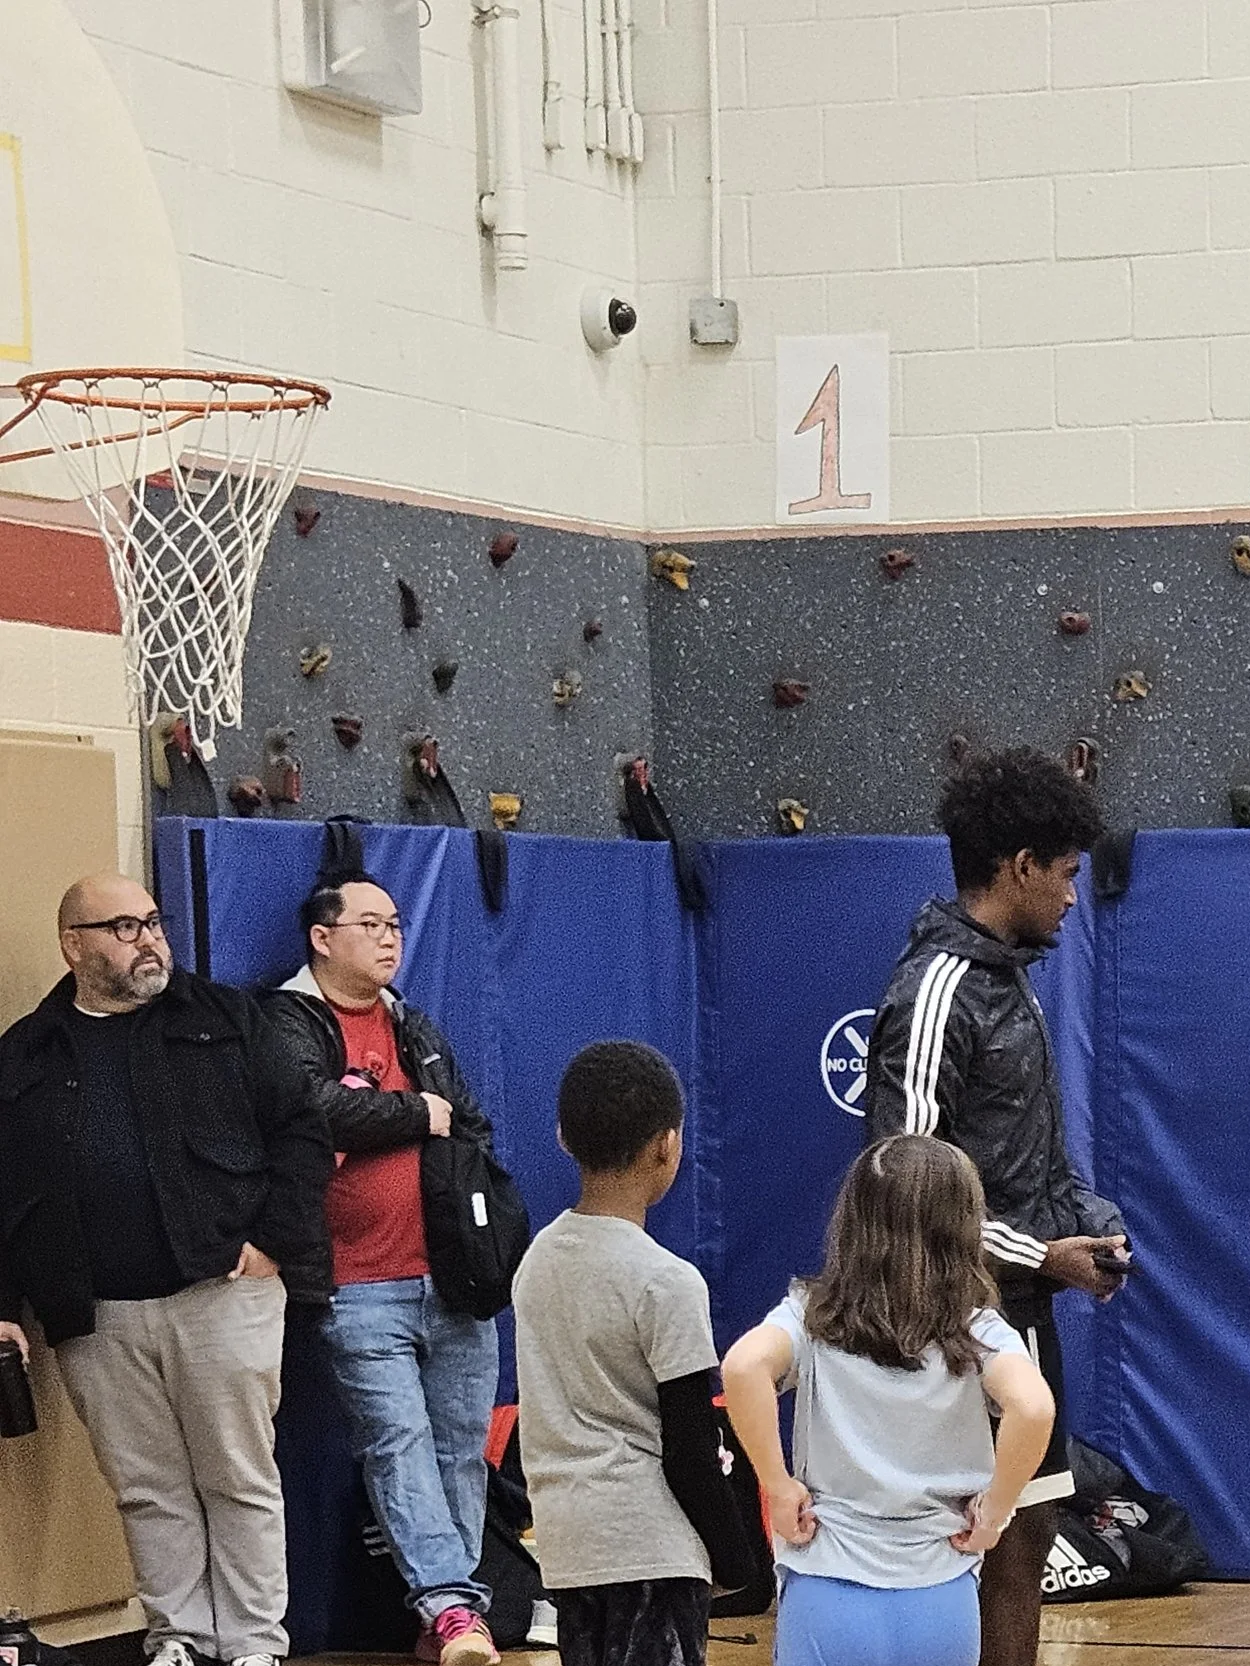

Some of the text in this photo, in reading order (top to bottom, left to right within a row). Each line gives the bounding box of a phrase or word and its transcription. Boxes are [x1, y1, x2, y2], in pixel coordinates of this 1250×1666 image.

[788, 363, 872, 515] 1
[827, 1058, 847, 1072] NO
[1040, 1560, 1111, 1593] didas
